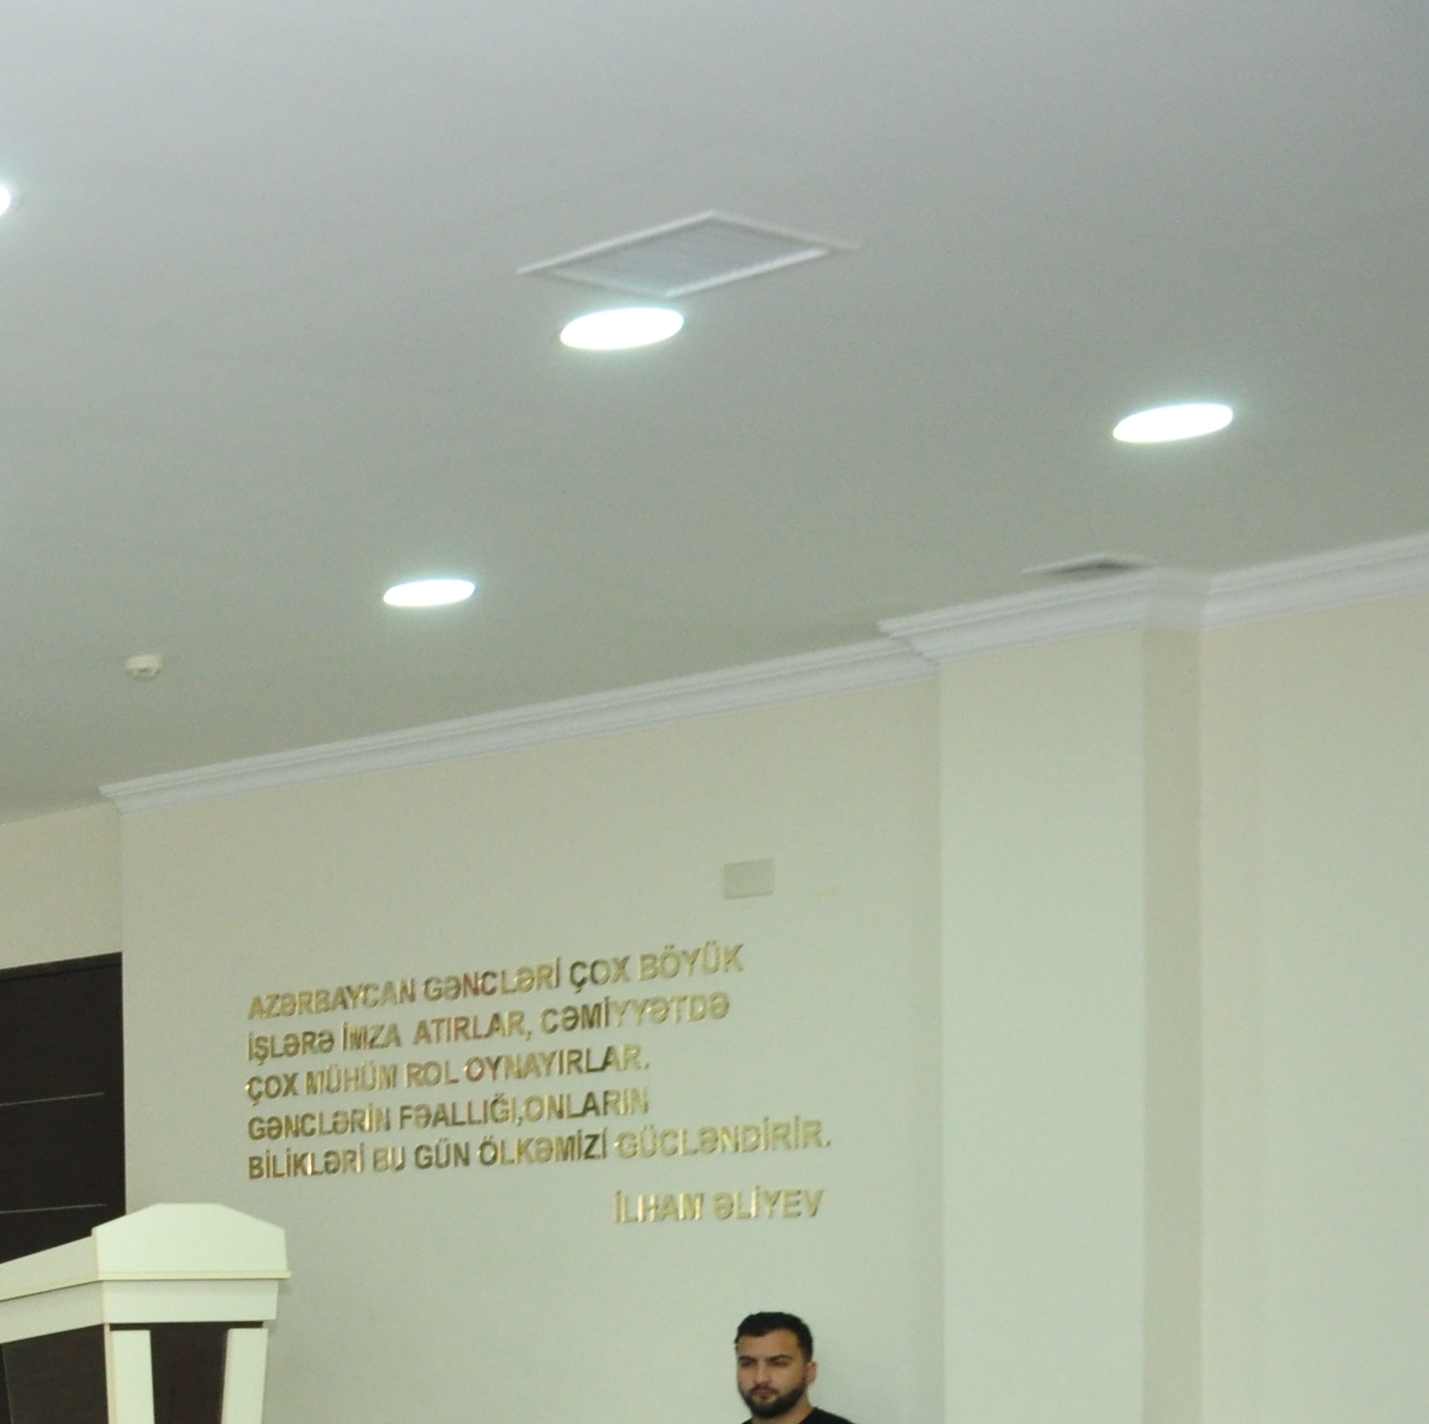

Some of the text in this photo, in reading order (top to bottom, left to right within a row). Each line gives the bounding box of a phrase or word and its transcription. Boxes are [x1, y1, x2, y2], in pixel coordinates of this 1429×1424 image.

[422, 957, 562, 1003] GƏNCLƏRİ
[569, 956, 631, 994] ÇOX
[637, 941, 745, 983] BÖYÜK
[412, 1008, 534, 1048] ATIRLAR,
[245, 1071, 300, 1107] ÇOX
[404, 1060, 460, 1088] ROL
[372, 1145, 405, 1172] BU
[414, 1136, 471, 1171] GÜN
[613, 1185, 825, 1224] İLHAM ƏLİYEV
